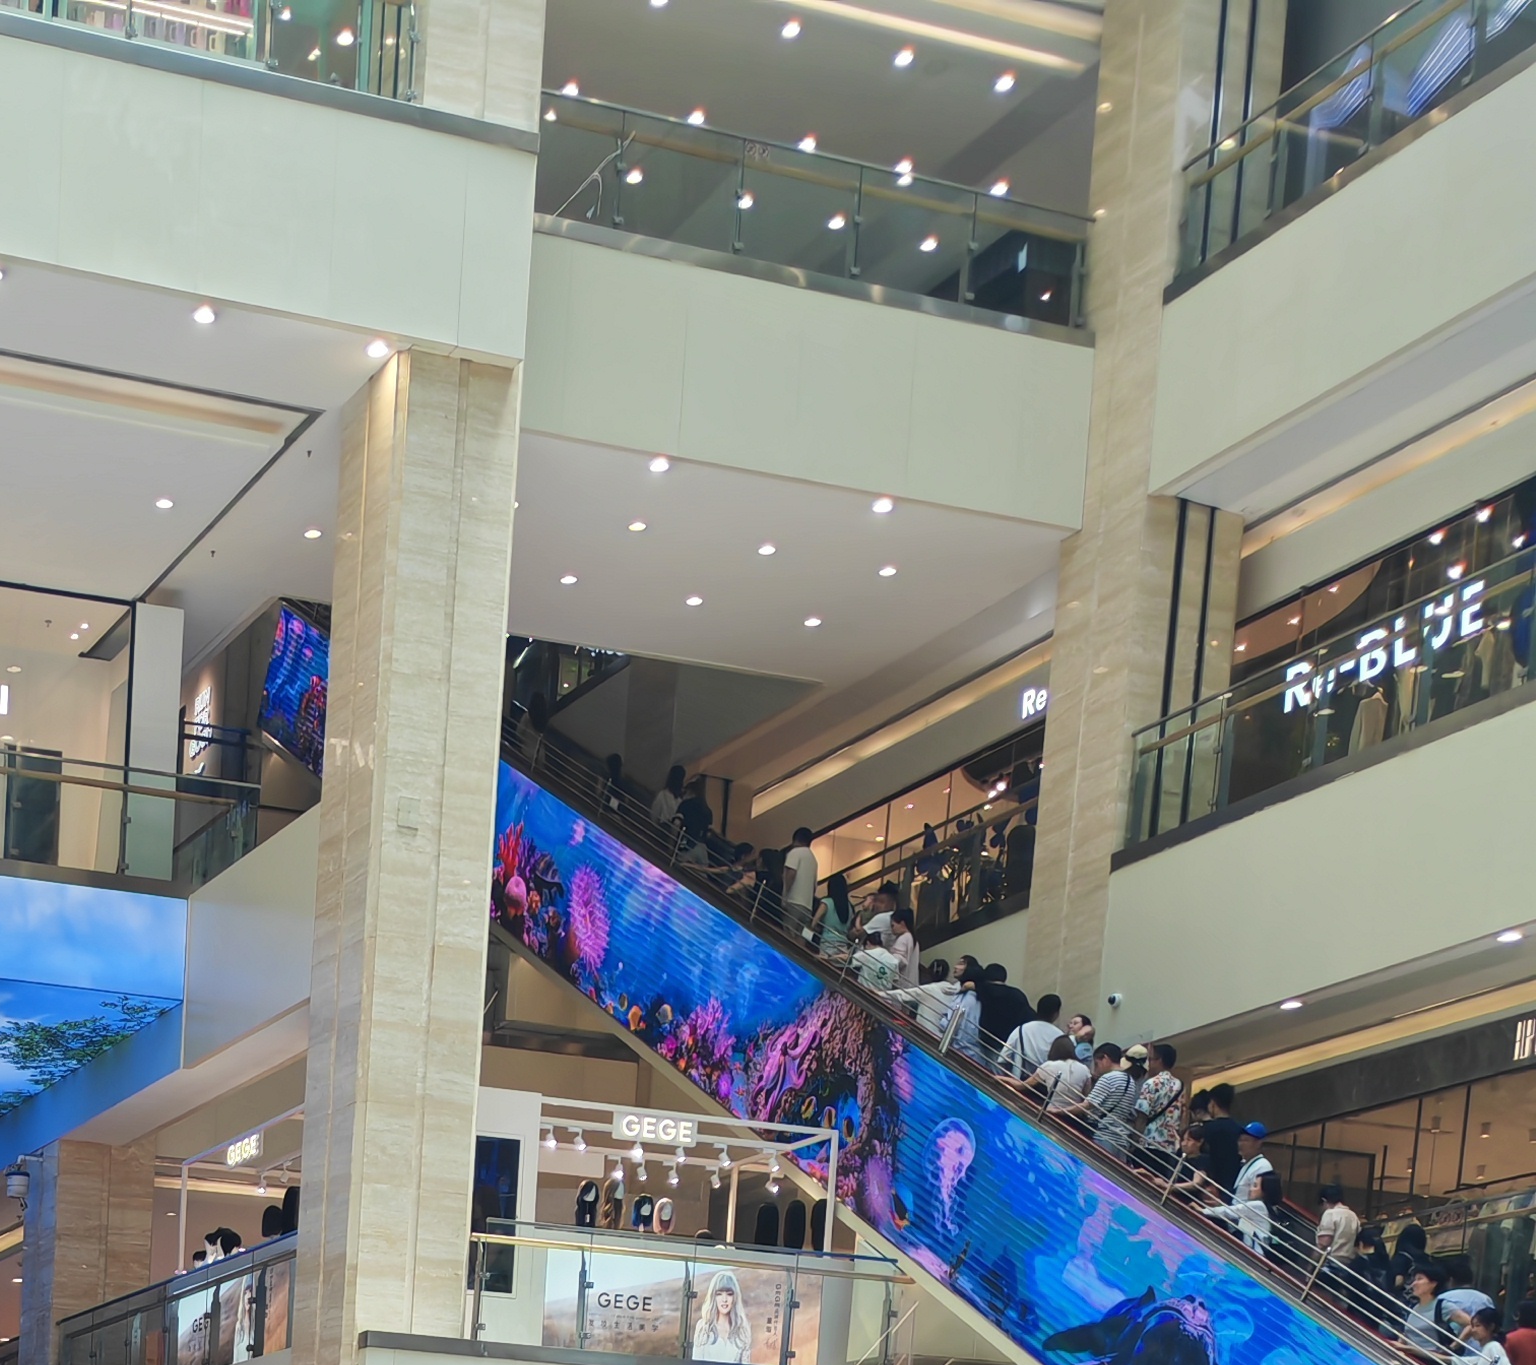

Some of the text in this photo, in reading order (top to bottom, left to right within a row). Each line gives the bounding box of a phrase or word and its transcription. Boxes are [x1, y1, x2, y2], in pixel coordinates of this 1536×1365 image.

[622, 1115, 693, 1142] GEGE
[227, 1133, 260, 1166] GEGE
[597, 1292, 652, 1312] GEGE
